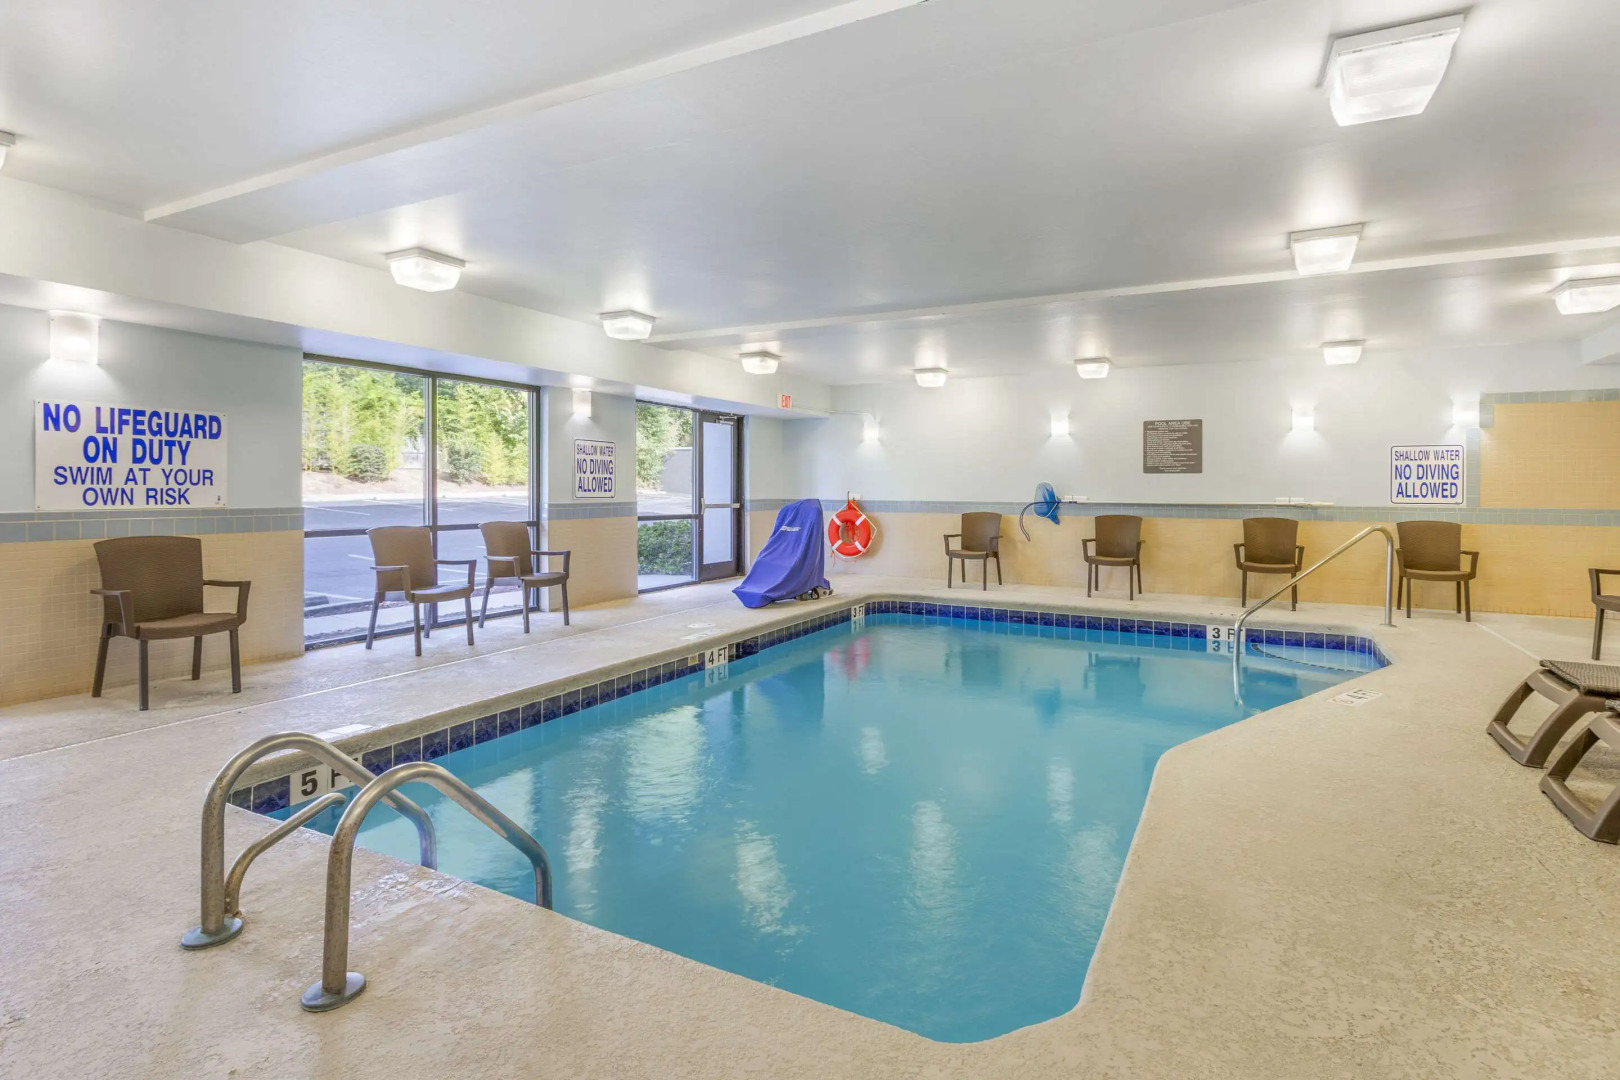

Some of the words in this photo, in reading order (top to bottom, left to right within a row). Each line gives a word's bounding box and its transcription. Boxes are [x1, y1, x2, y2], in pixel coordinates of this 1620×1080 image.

[43, 403, 81, 432] NO
[95, 407, 222, 440] LIFEGUARD
[83, 435, 118, 464] ON
[132, 438, 191, 465] DUTY
[576, 443, 598, 456] SHALLOW
[599, 445, 613, 457] WATER
[1394, 450, 1430, 461] SHALLOW
[1433, 449, 1460, 461] WATER
[576, 458, 588, 474] NO
[589, 458, 614, 475] DIVING
[1394, 464, 1412, 480] NO
[1416, 463, 1460, 481] DIVING
[53, 465, 112, 485] SWIM
[124, 467, 151, 485] AT
[161, 468, 214, 486] YOUR
[577, 476, 613, 493] ALLOWED
[1395, 482, 1459, 498] ALLOWED
[82, 487, 134, 506] OWN
[145, 487, 190, 506] RISK
[853, 607, 858, 618] 3
[859, 605, 865, 617] FT
[1212, 627, 1221, 639] 3
[708, 650, 715, 666] 4
[717, 646, 728, 663] FT
[301, 769, 318, 797] 5
